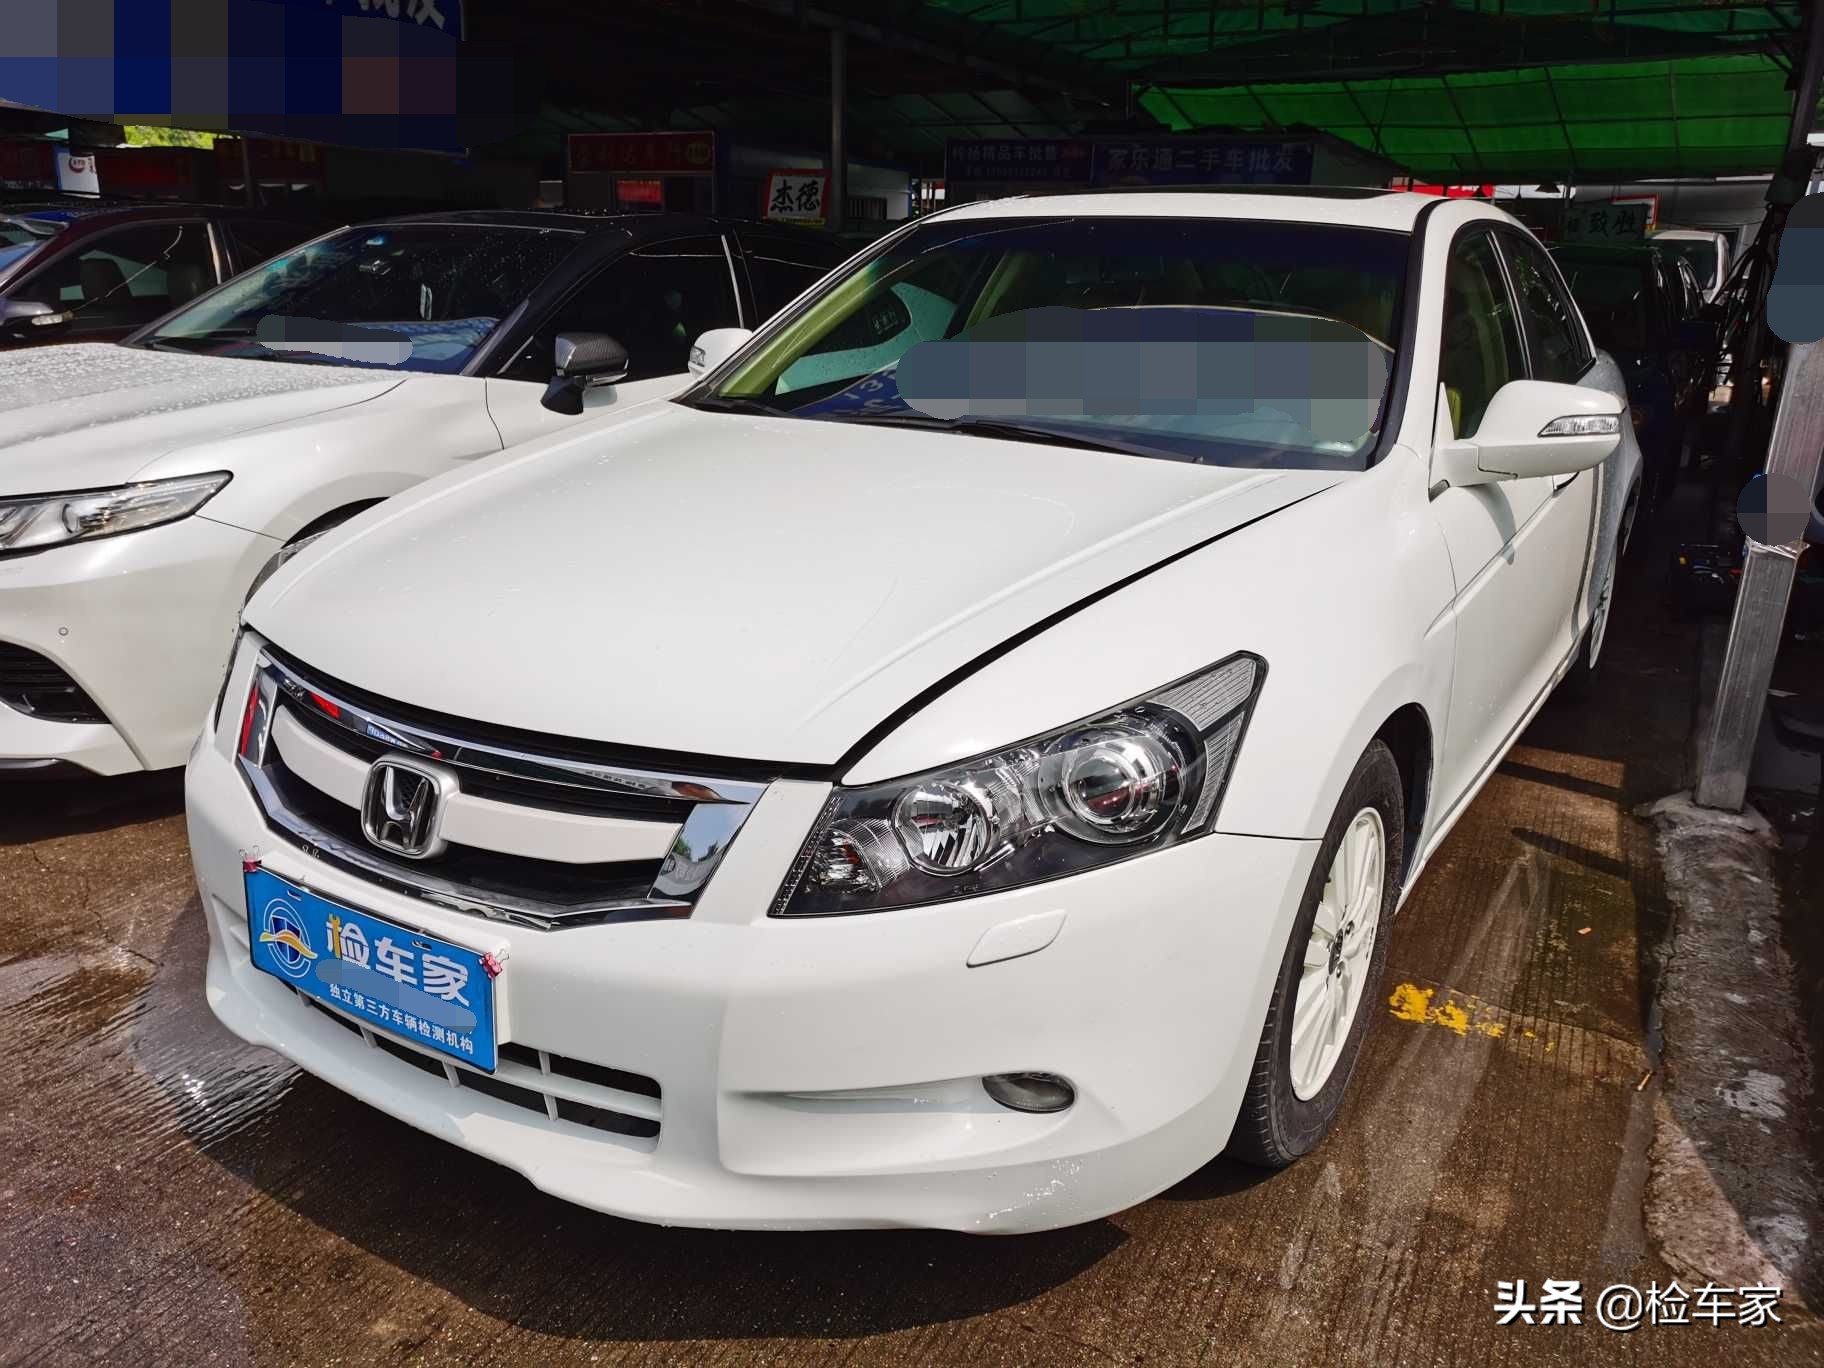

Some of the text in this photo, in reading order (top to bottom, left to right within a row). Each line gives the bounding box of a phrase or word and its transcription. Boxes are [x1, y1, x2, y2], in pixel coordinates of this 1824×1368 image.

[768, 176, 819, 213] 杰德
[326, 913, 470, 1007] 检车家
[328, 983, 474, 1055] 独立第三方车辆检测机构
